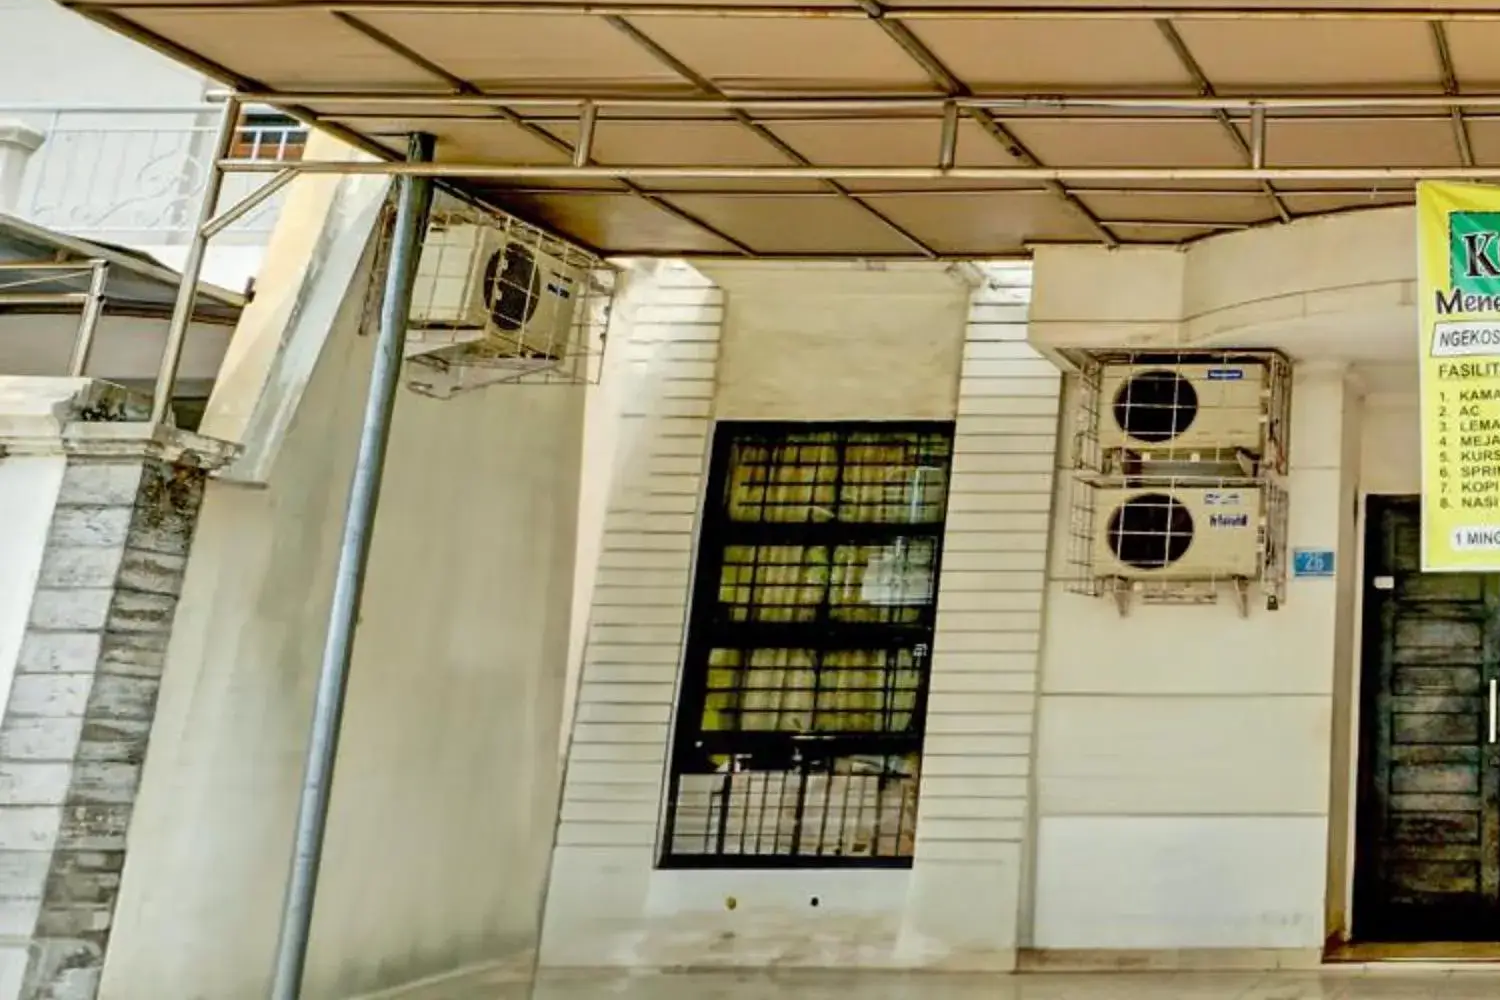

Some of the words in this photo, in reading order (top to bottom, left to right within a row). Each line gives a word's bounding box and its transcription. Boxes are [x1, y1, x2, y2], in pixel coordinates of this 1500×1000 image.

[1459, 405, 1480, 416] AC
[1461, 479, 1499, 493] KOPI
[1461, 496, 1499, 508] NASI
[1455, 532, 1462, 546] 1
